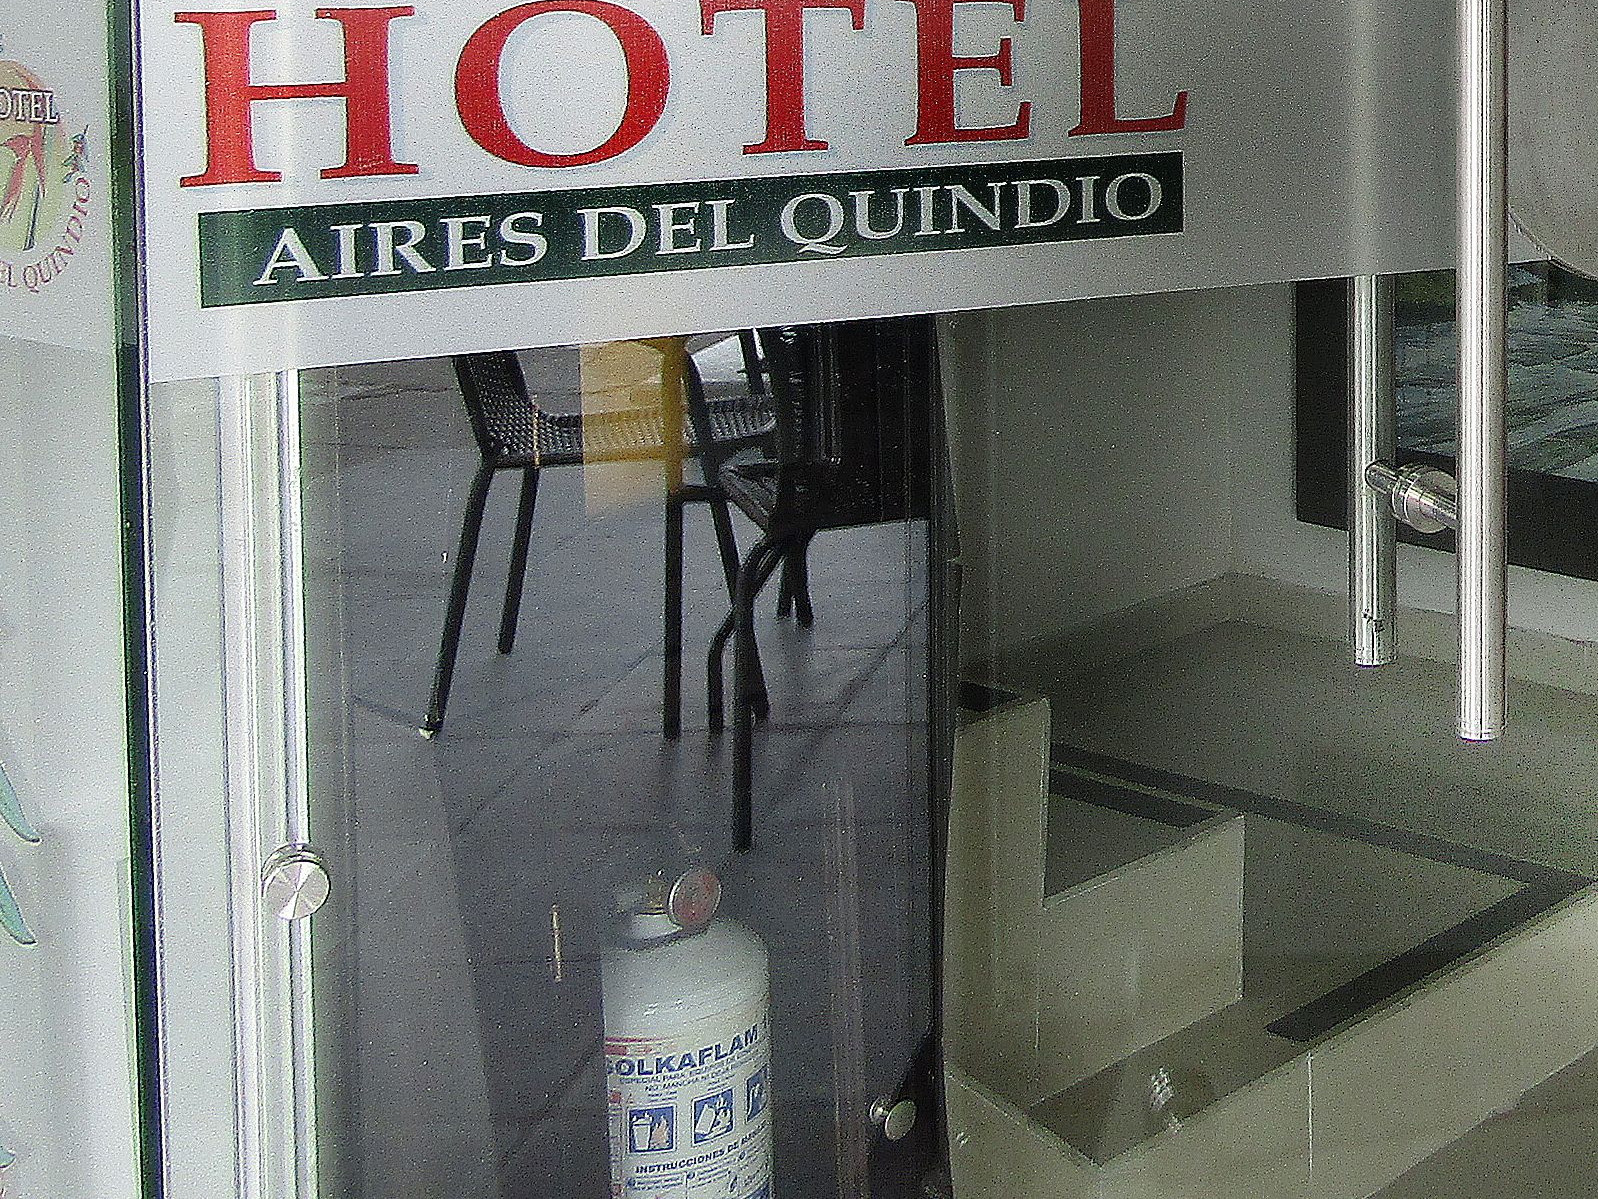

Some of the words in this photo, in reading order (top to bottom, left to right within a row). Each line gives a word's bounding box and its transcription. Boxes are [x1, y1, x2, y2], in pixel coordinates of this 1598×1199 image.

[22, 177, 91, 293] QUINDIO
[252, 212, 549, 287] AIRES
[579, 198, 756, 262] DEL
[778, 171, 1163, 256] QUINDIO
[634, 1149, 726, 1175] INSTRUCCIONES
